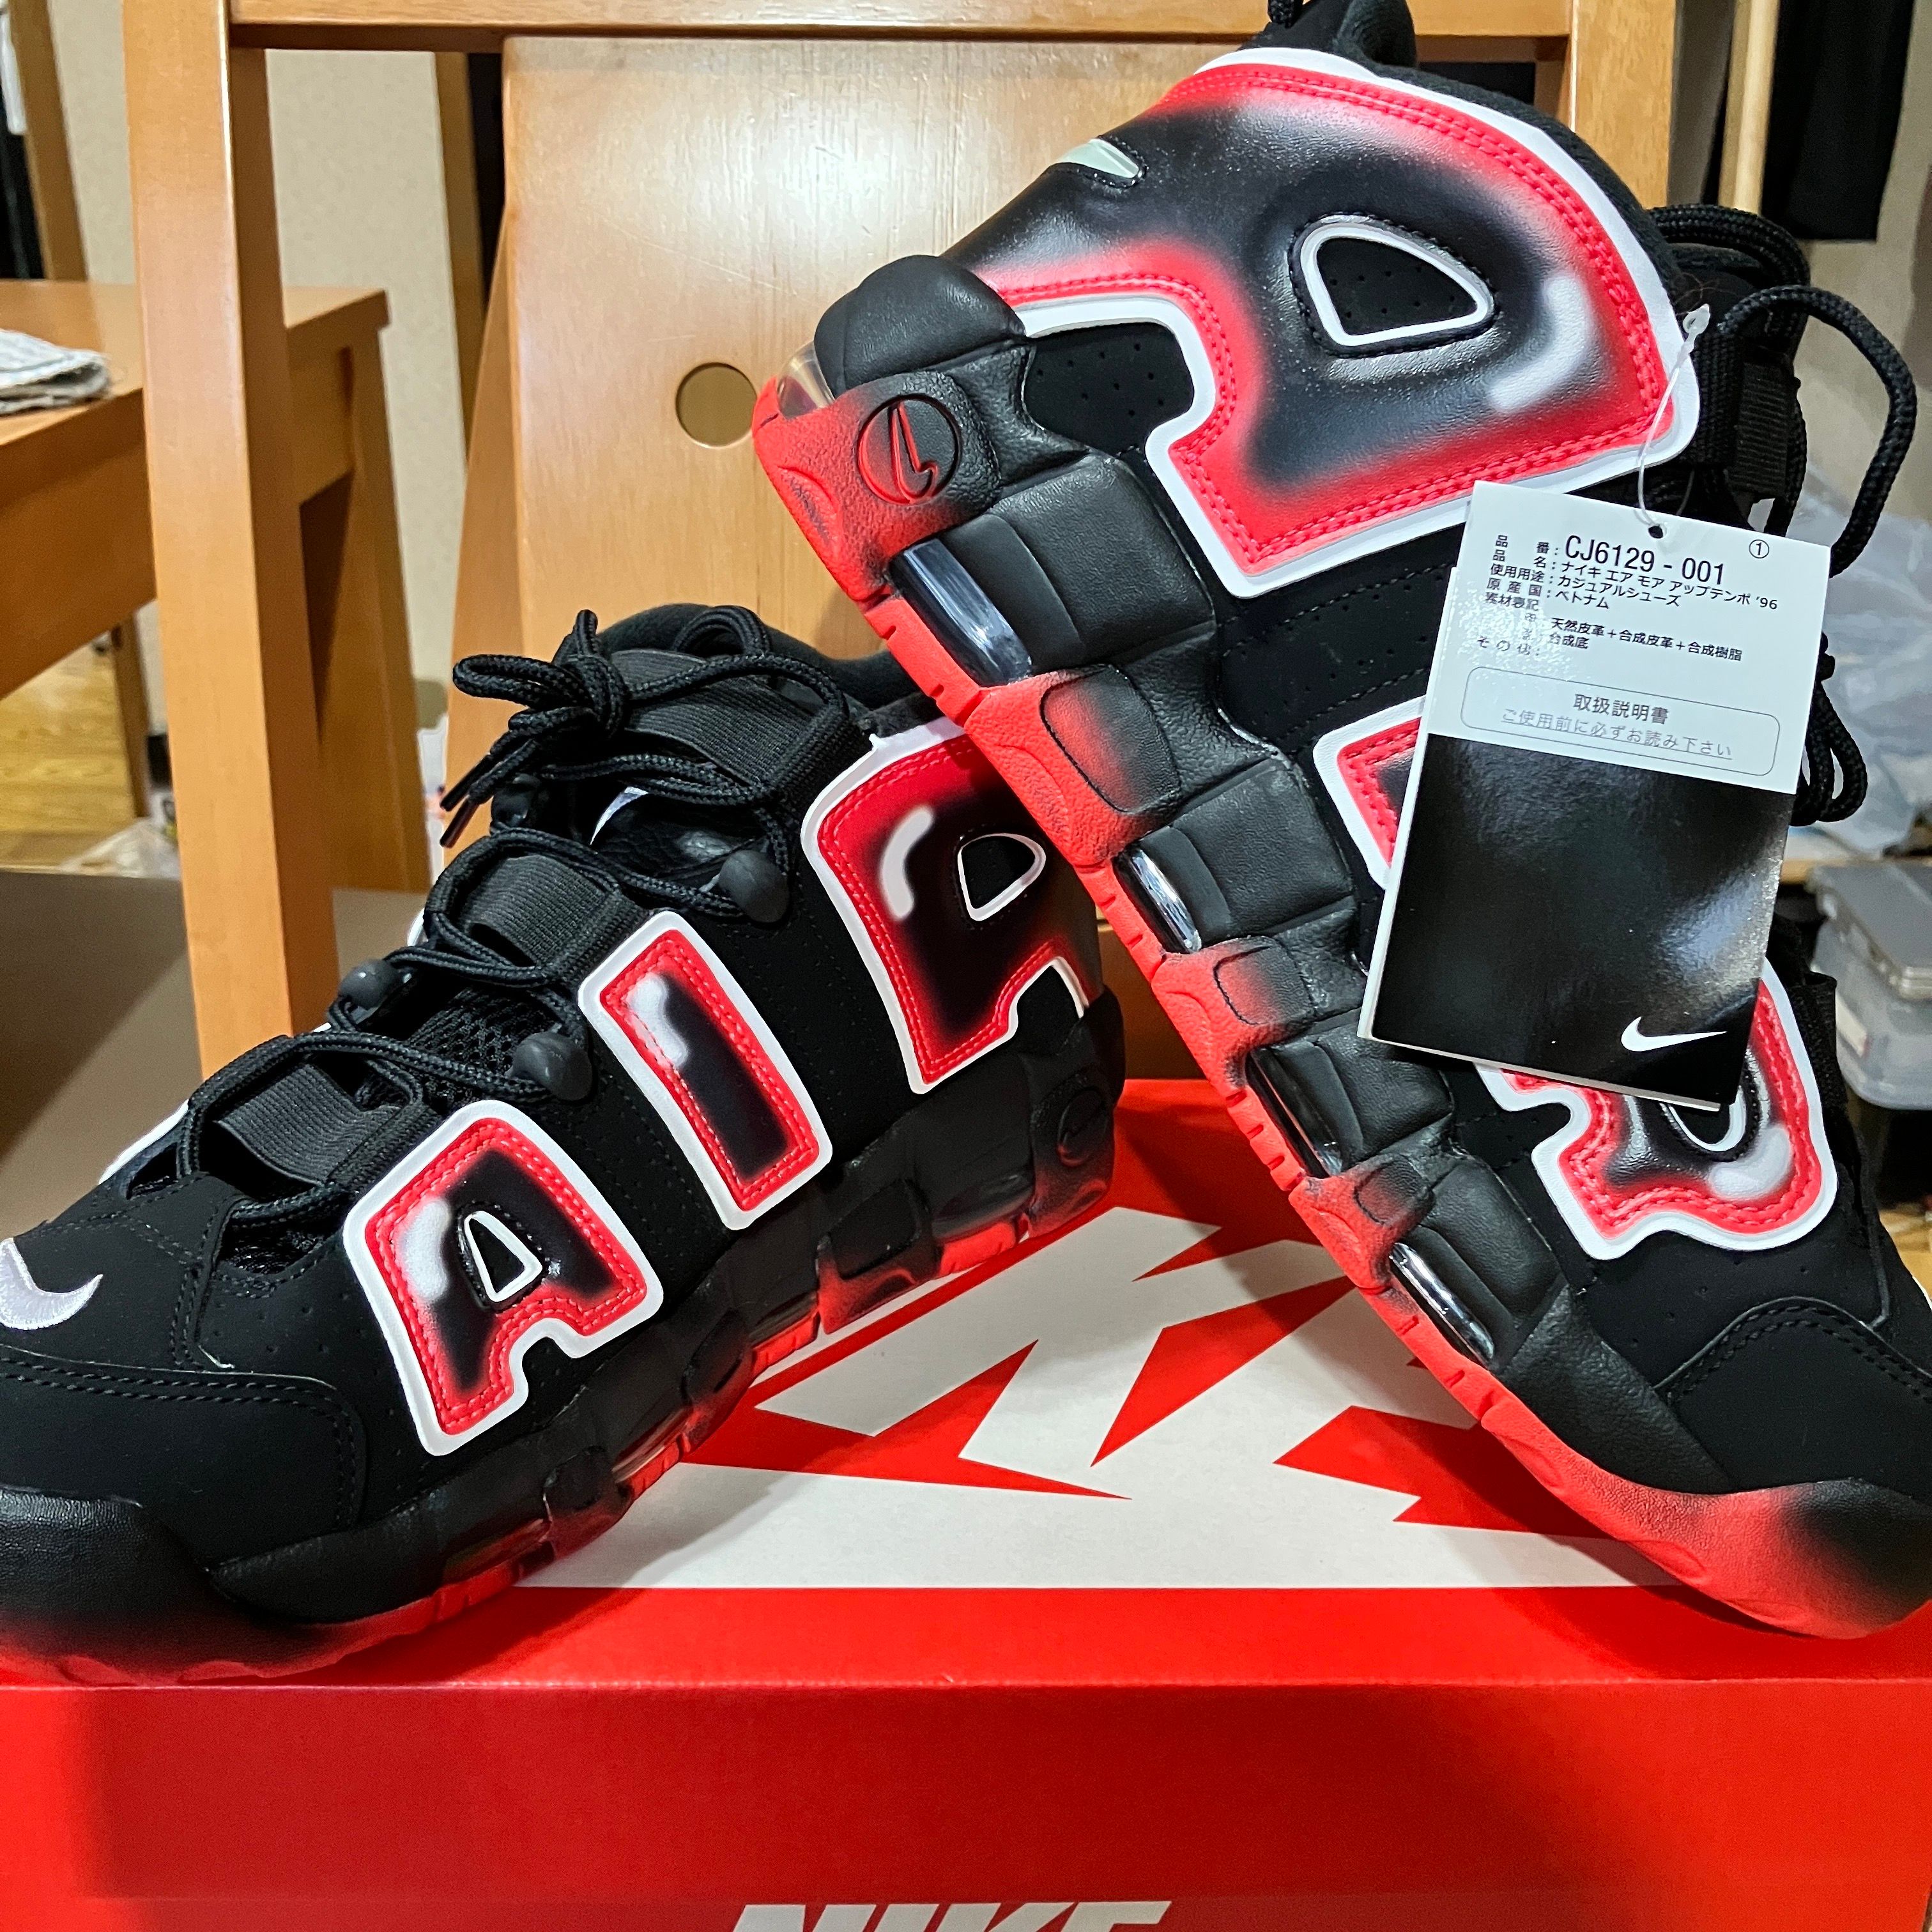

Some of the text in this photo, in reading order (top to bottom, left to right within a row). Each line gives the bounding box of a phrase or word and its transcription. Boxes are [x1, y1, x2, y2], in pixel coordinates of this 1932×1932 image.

[1573, 693, 1669, 724] 取扱説明書
[1501, 709, 1731, 756] ご使用前に必ずお読み下さい
